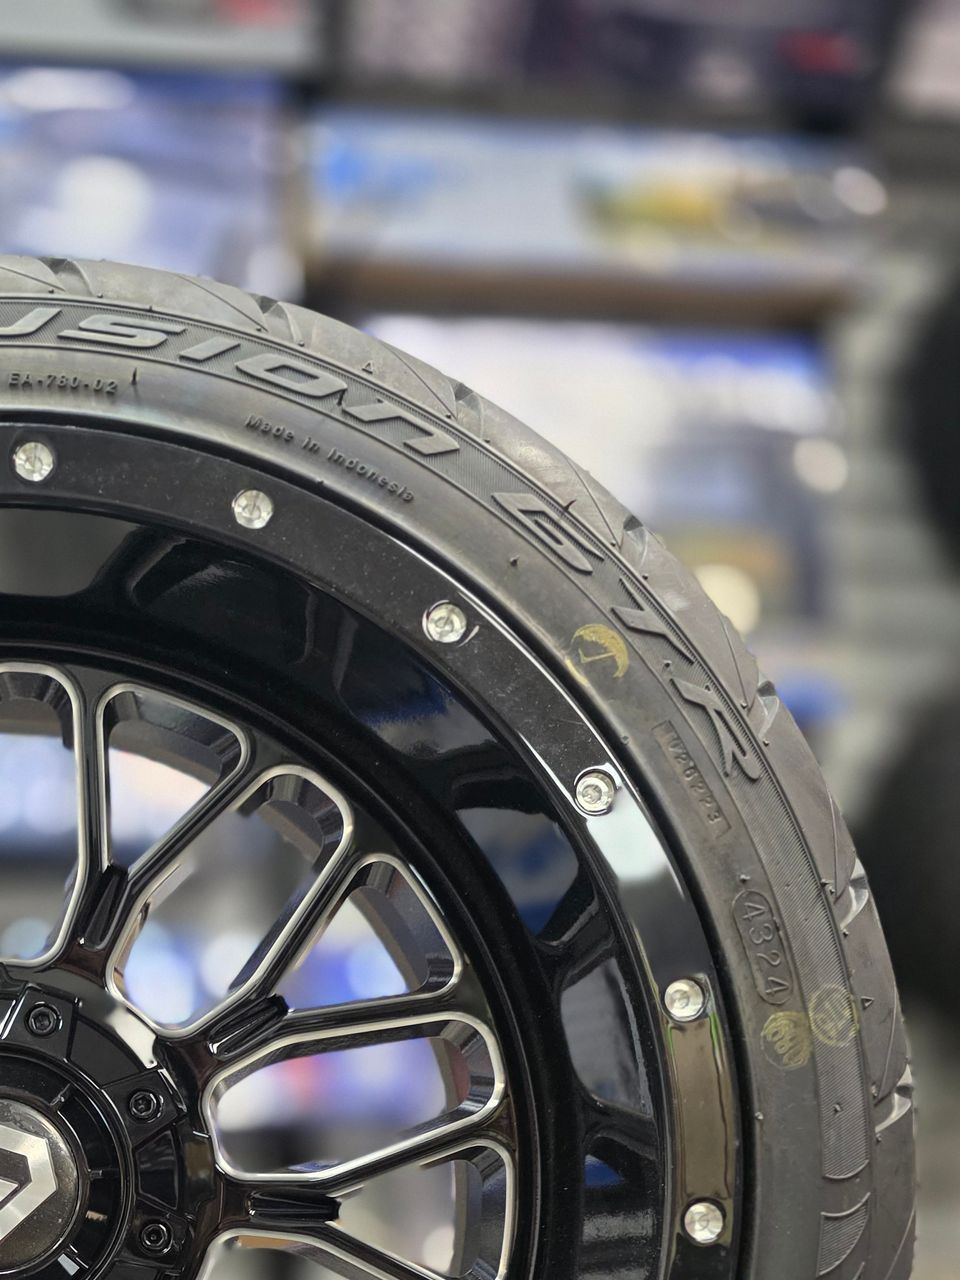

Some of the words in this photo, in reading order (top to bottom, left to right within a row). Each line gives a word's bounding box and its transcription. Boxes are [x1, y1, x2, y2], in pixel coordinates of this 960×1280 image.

[244, 415, 294, 444] Made
[301, 437, 320, 454] in
[326, 447, 414, 504] Indonesia
[742, 895, 792, 1000] 4324
